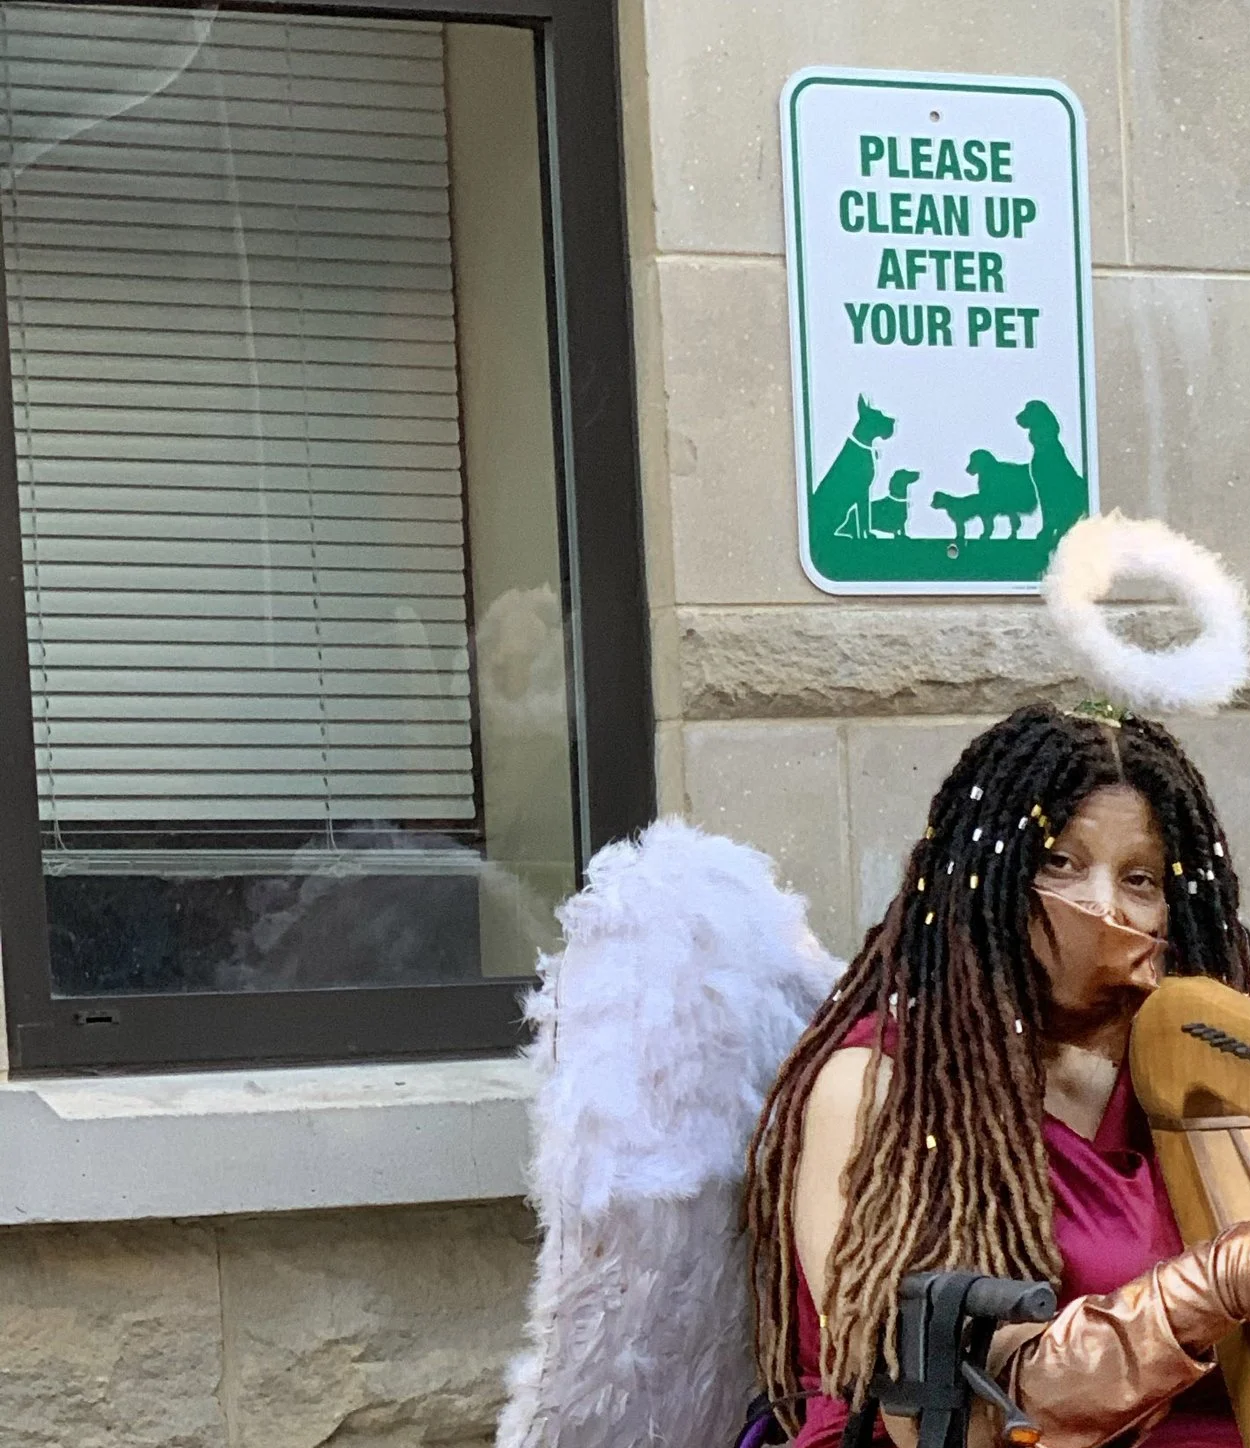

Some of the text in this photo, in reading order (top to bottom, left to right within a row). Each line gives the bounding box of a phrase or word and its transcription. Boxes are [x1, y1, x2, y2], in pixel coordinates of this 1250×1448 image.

[859, 135, 1013, 183] PLEASE
[839, 190, 1037, 239] CLEAN UP
[877, 248, 1005, 293] AFTER
[844, 303, 1041, 349] YOUR PET
